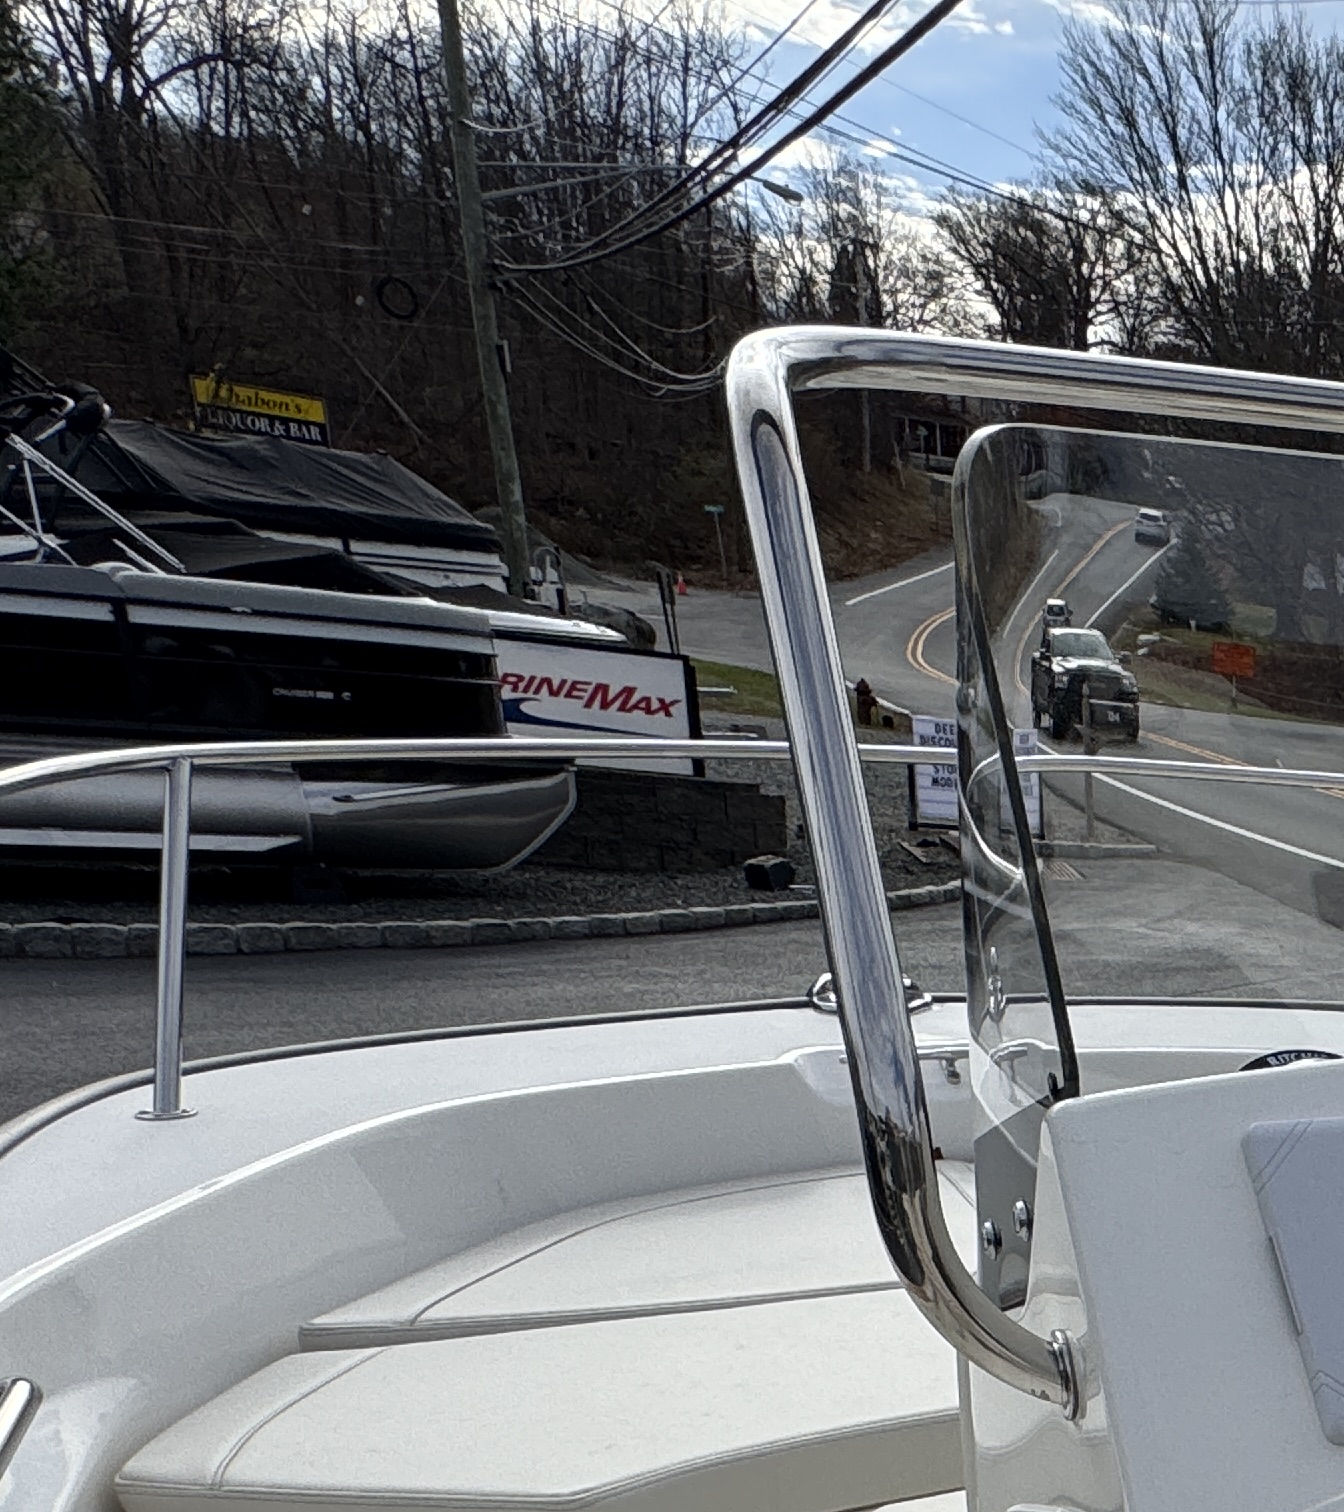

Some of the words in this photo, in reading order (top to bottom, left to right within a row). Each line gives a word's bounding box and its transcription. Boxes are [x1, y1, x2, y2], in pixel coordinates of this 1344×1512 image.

[270, 417, 286, 436] &
[288, 422, 323, 442] BAR
[500, 672, 682, 718] RINEMAX
